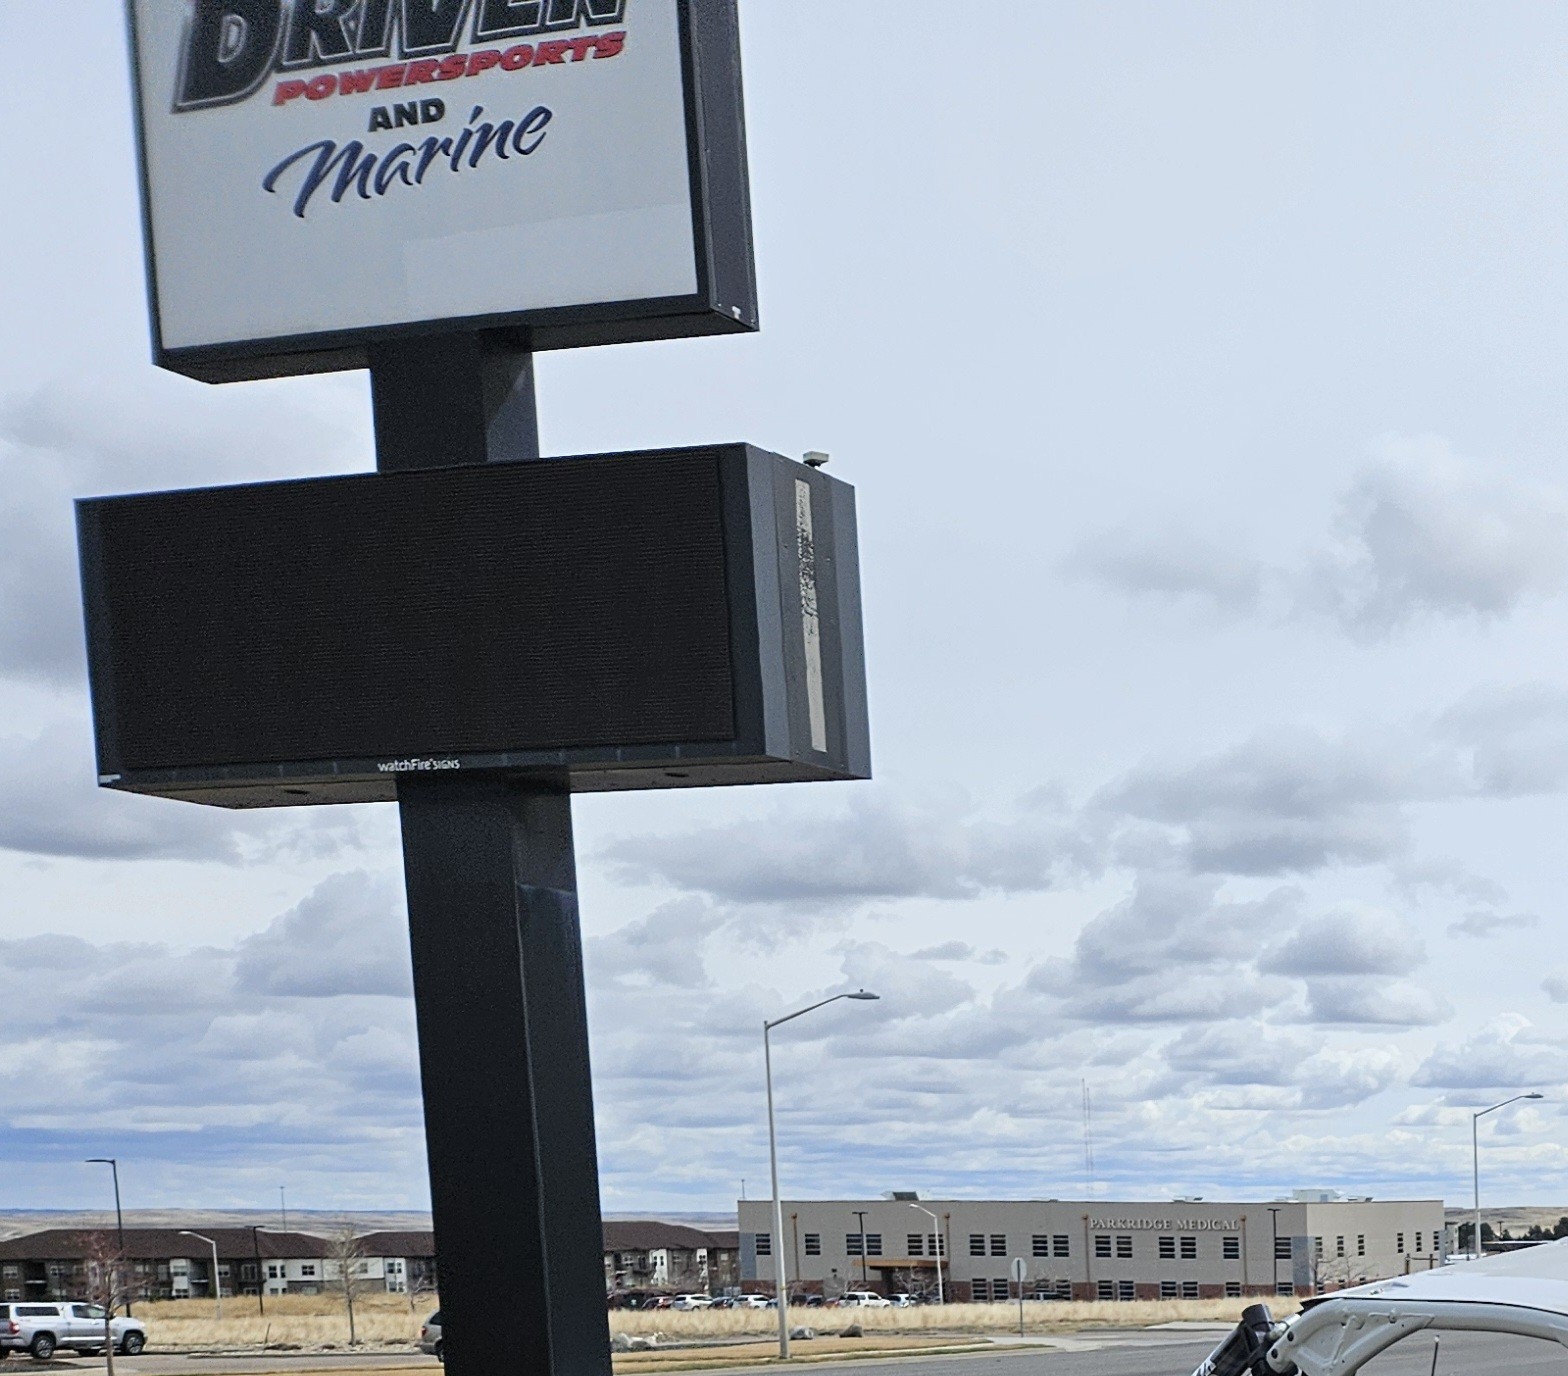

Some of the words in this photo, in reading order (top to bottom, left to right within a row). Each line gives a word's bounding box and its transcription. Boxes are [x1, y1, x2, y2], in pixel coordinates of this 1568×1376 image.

[271, 32, 627, 107] POWERSPORTS
[367, 98, 446, 133] AND
[262, 104, 553, 218] Marine
[1090, 1218, 1172, 1231] PARKRIDGE
[1177, 1218, 1240, 1231] MEDICAL
